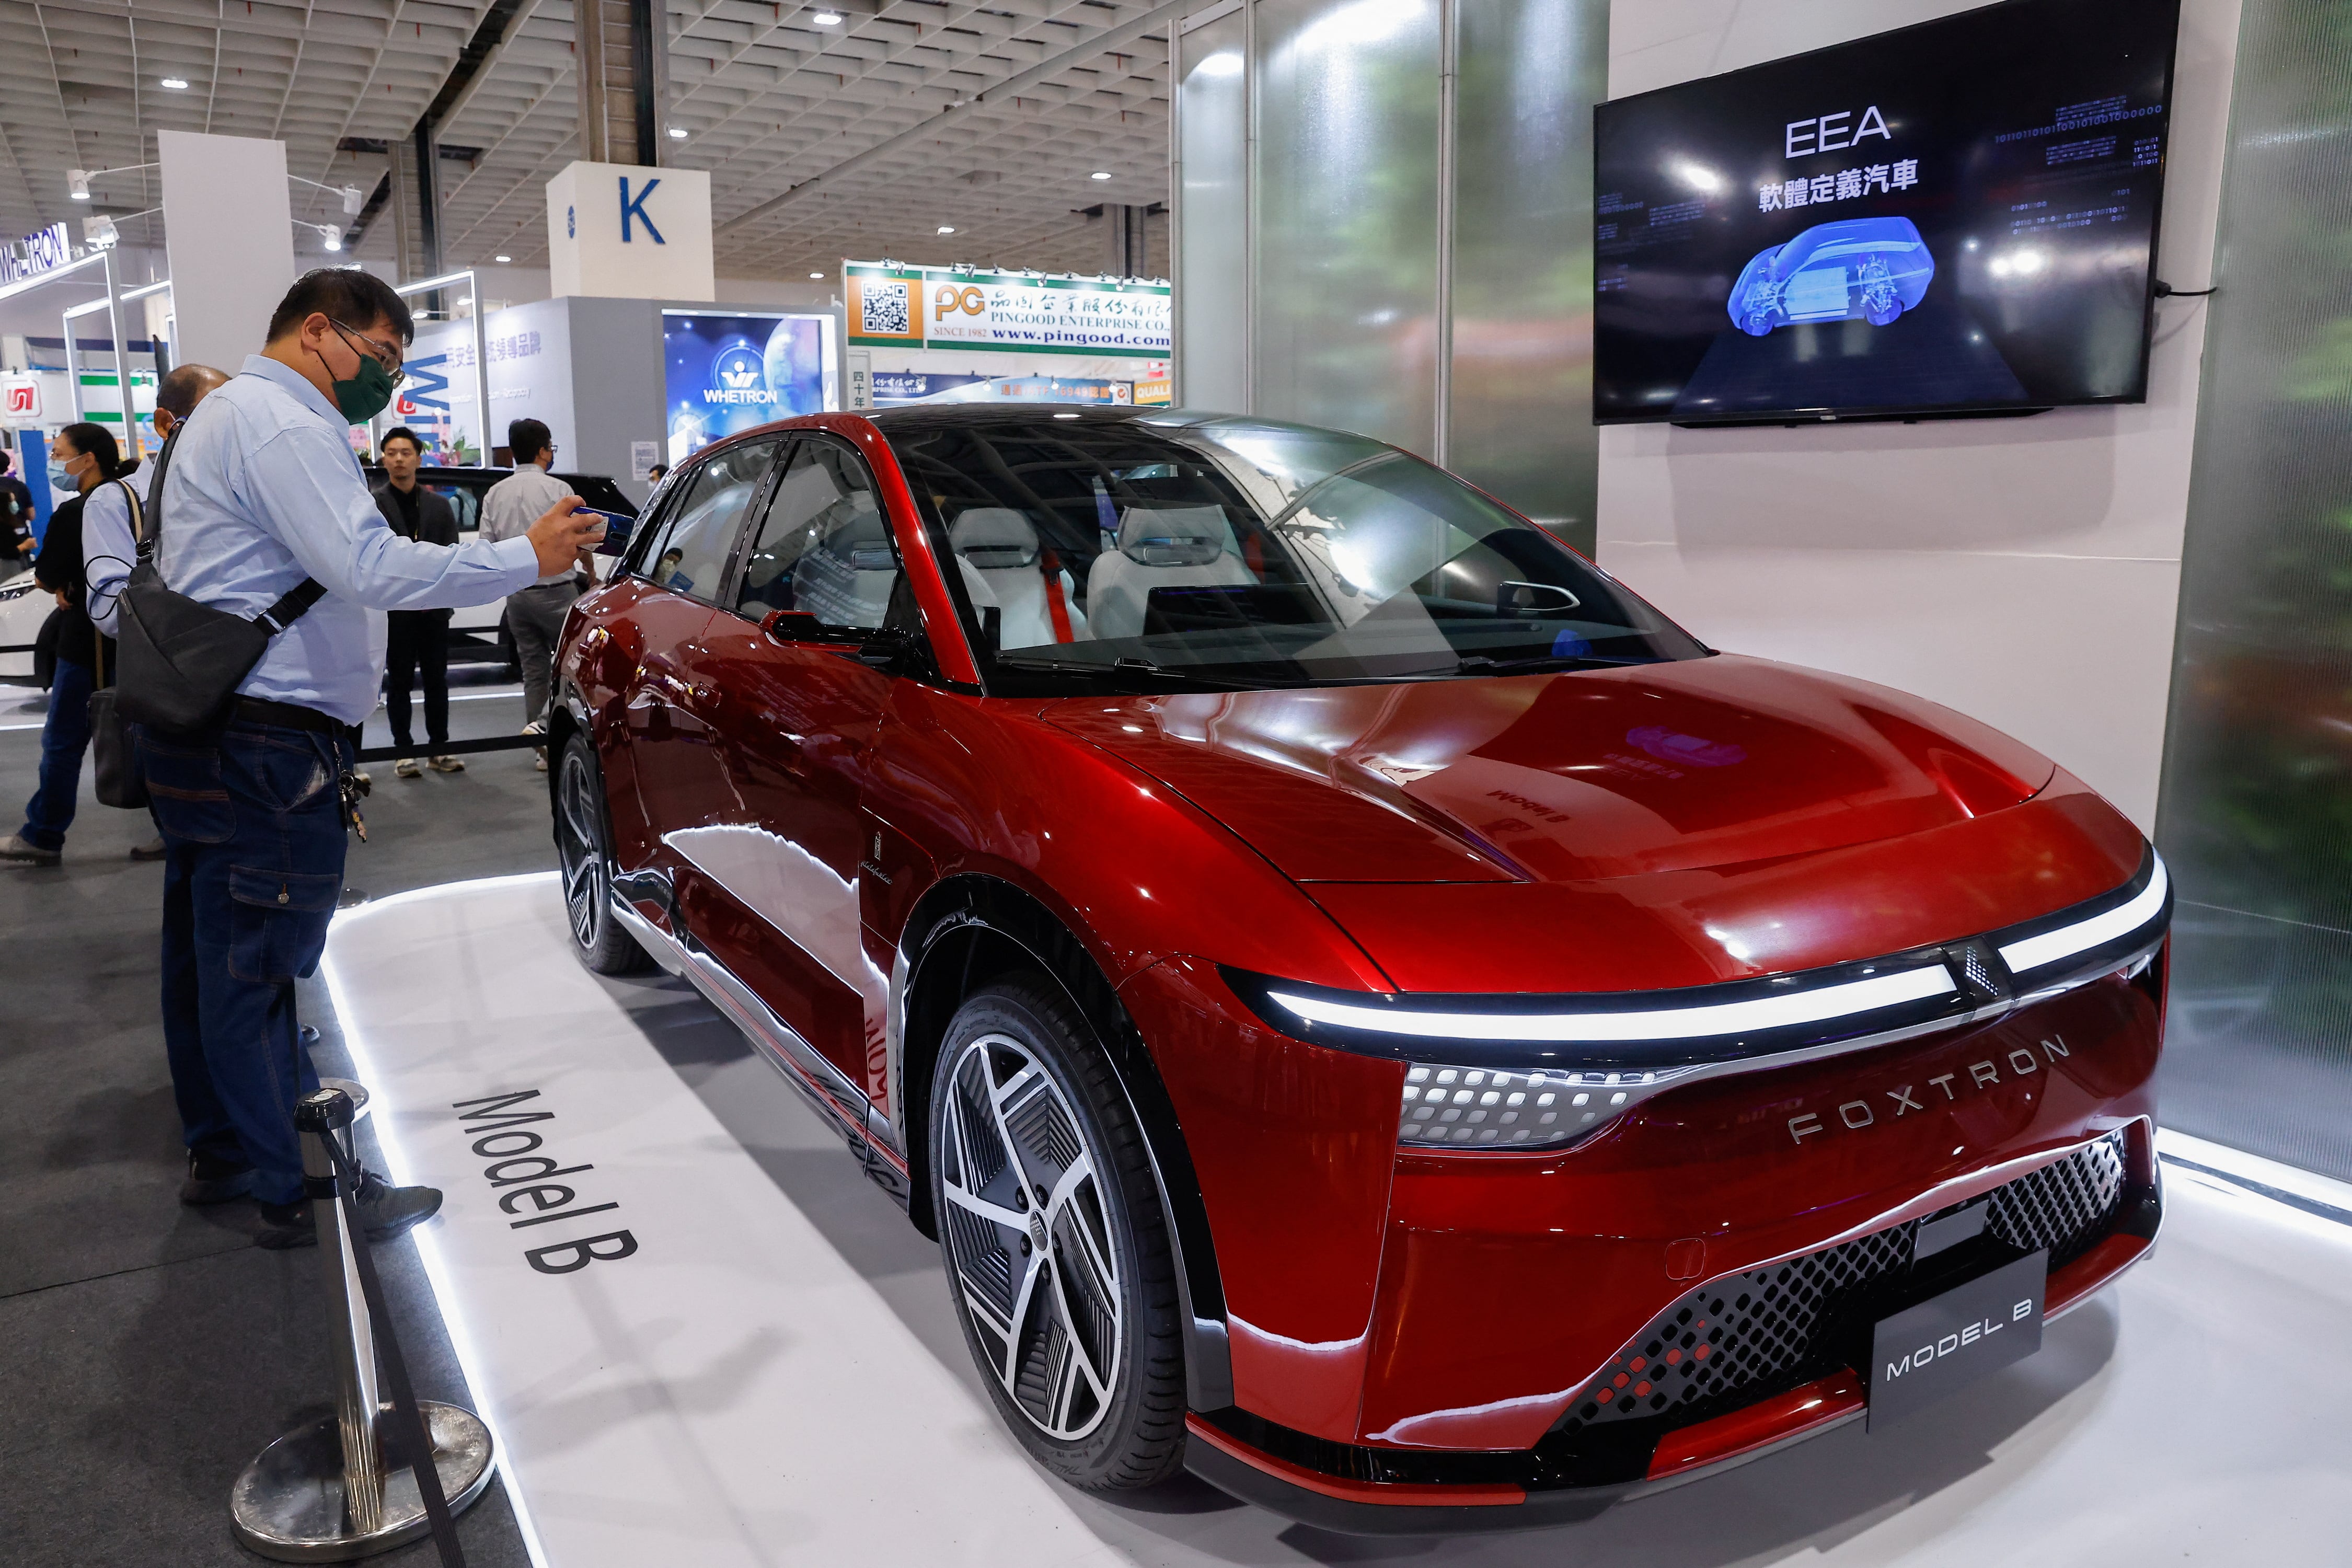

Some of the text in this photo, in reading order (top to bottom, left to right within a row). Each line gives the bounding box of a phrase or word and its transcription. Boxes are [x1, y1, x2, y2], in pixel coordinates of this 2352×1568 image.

[1785, 106, 1891, 158] EEA
[1758, 159, 1919, 213] 軟體定義汽車
[619, 177, 665, 245] K
[991, 289, 1171, 317] 品固企業股份有限
[991, 312, 1055, 325] PINGOOD
[1060, 315, 1142, 329] ENTERPRISE
[934, 326, 987, 338] SINCE 1982
[991, 329, 1170, 345] www.pingood.com
[702, 388, 778, 404] WHETRON
[854, 371, 865, 408] 四十年
[1788, 1034, 2071, 1145] FOXTRON
[452, 1089, 639, 1275] Model B
[1885, 1298, 2033, 1381] MODEL B
